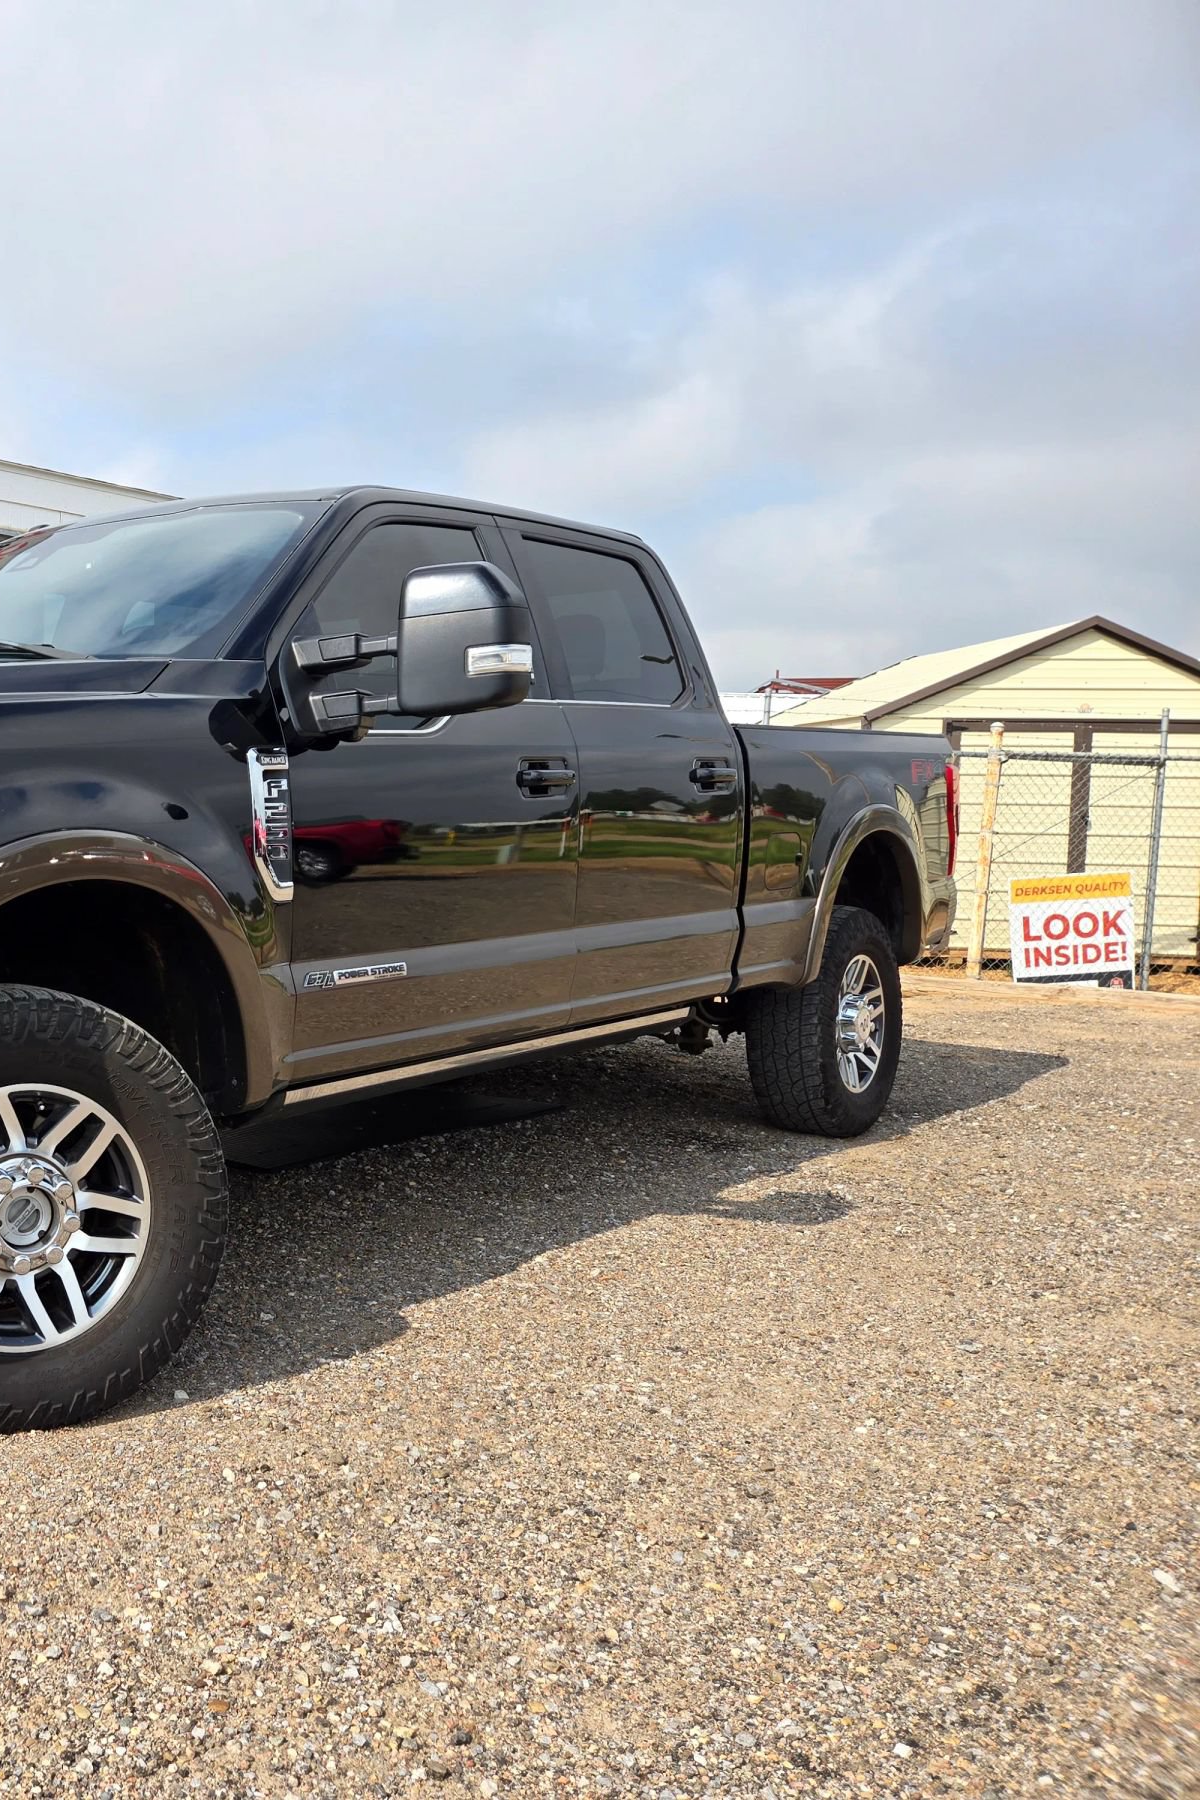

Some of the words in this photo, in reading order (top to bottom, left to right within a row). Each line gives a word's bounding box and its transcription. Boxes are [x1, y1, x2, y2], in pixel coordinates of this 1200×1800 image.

[1015, 884, 1072, 897] DERKSEN
[1075, 881, 1127, 894] QUALITY
[1022, 909, 1127, 942] LOOK
[1024, 941, 1127, 968] INSIDE!
[370, 964, 406, 976] STROKE
